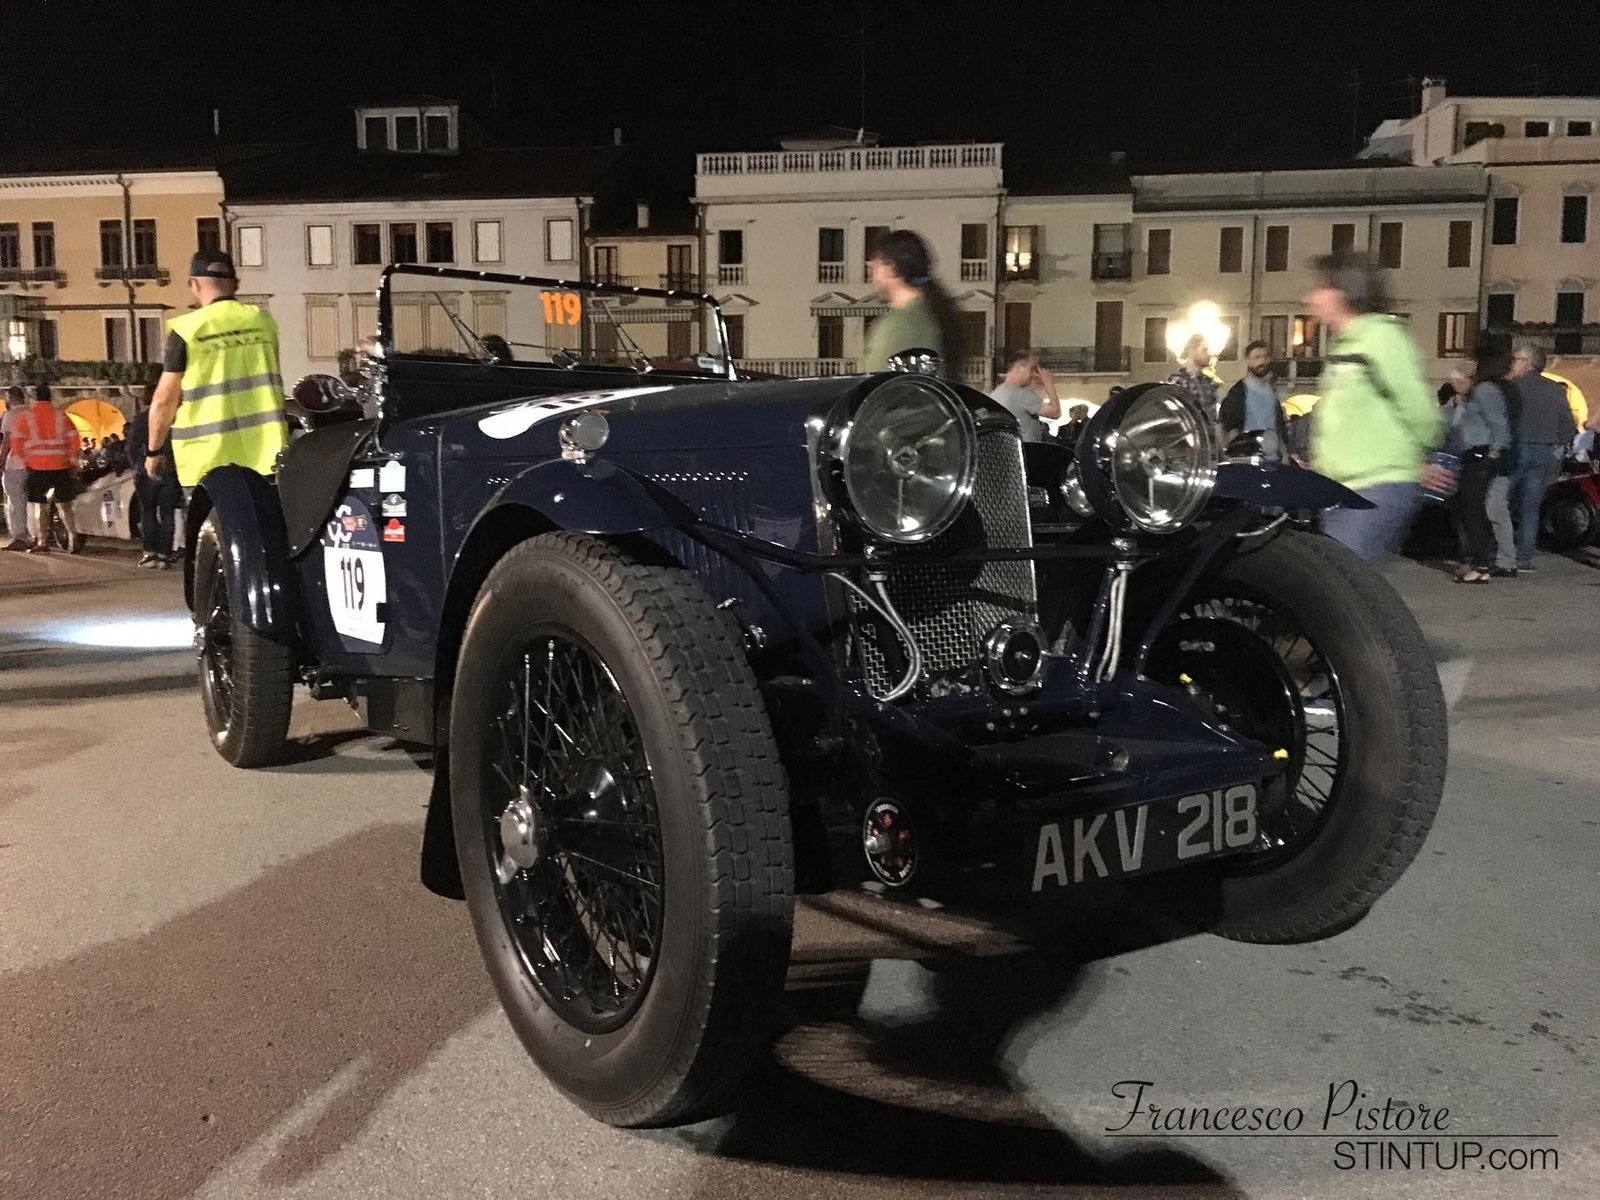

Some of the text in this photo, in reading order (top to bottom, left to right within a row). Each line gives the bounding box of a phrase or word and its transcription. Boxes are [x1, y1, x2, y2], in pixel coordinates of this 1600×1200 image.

[538, 291, 582, 325] 119
[340, 556, 365, 611] 119
[1031, 783, 1258, 892] AKV 218
